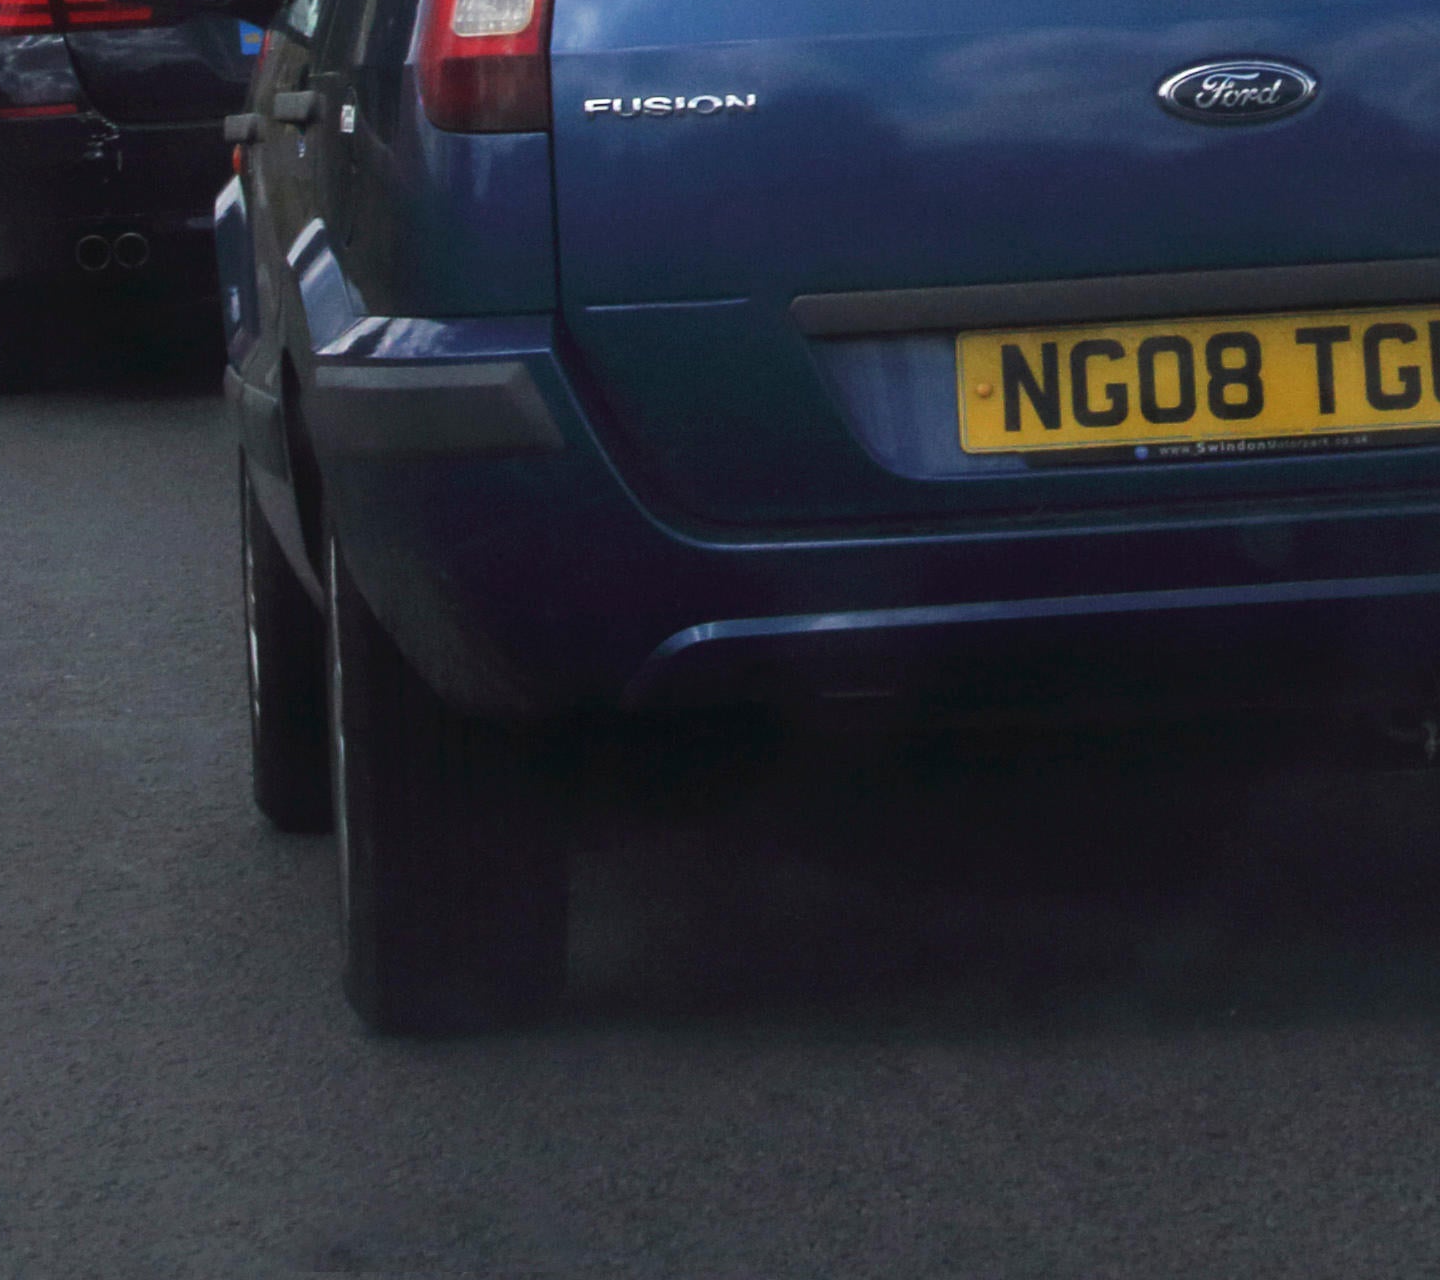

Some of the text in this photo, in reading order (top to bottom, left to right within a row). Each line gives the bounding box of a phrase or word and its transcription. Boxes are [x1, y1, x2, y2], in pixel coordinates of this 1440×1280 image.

[584, 93, 756, 119] FUSION
[1195, 72, 1283, 109] Ford
[1000, 332, 1264, 432] NG08
